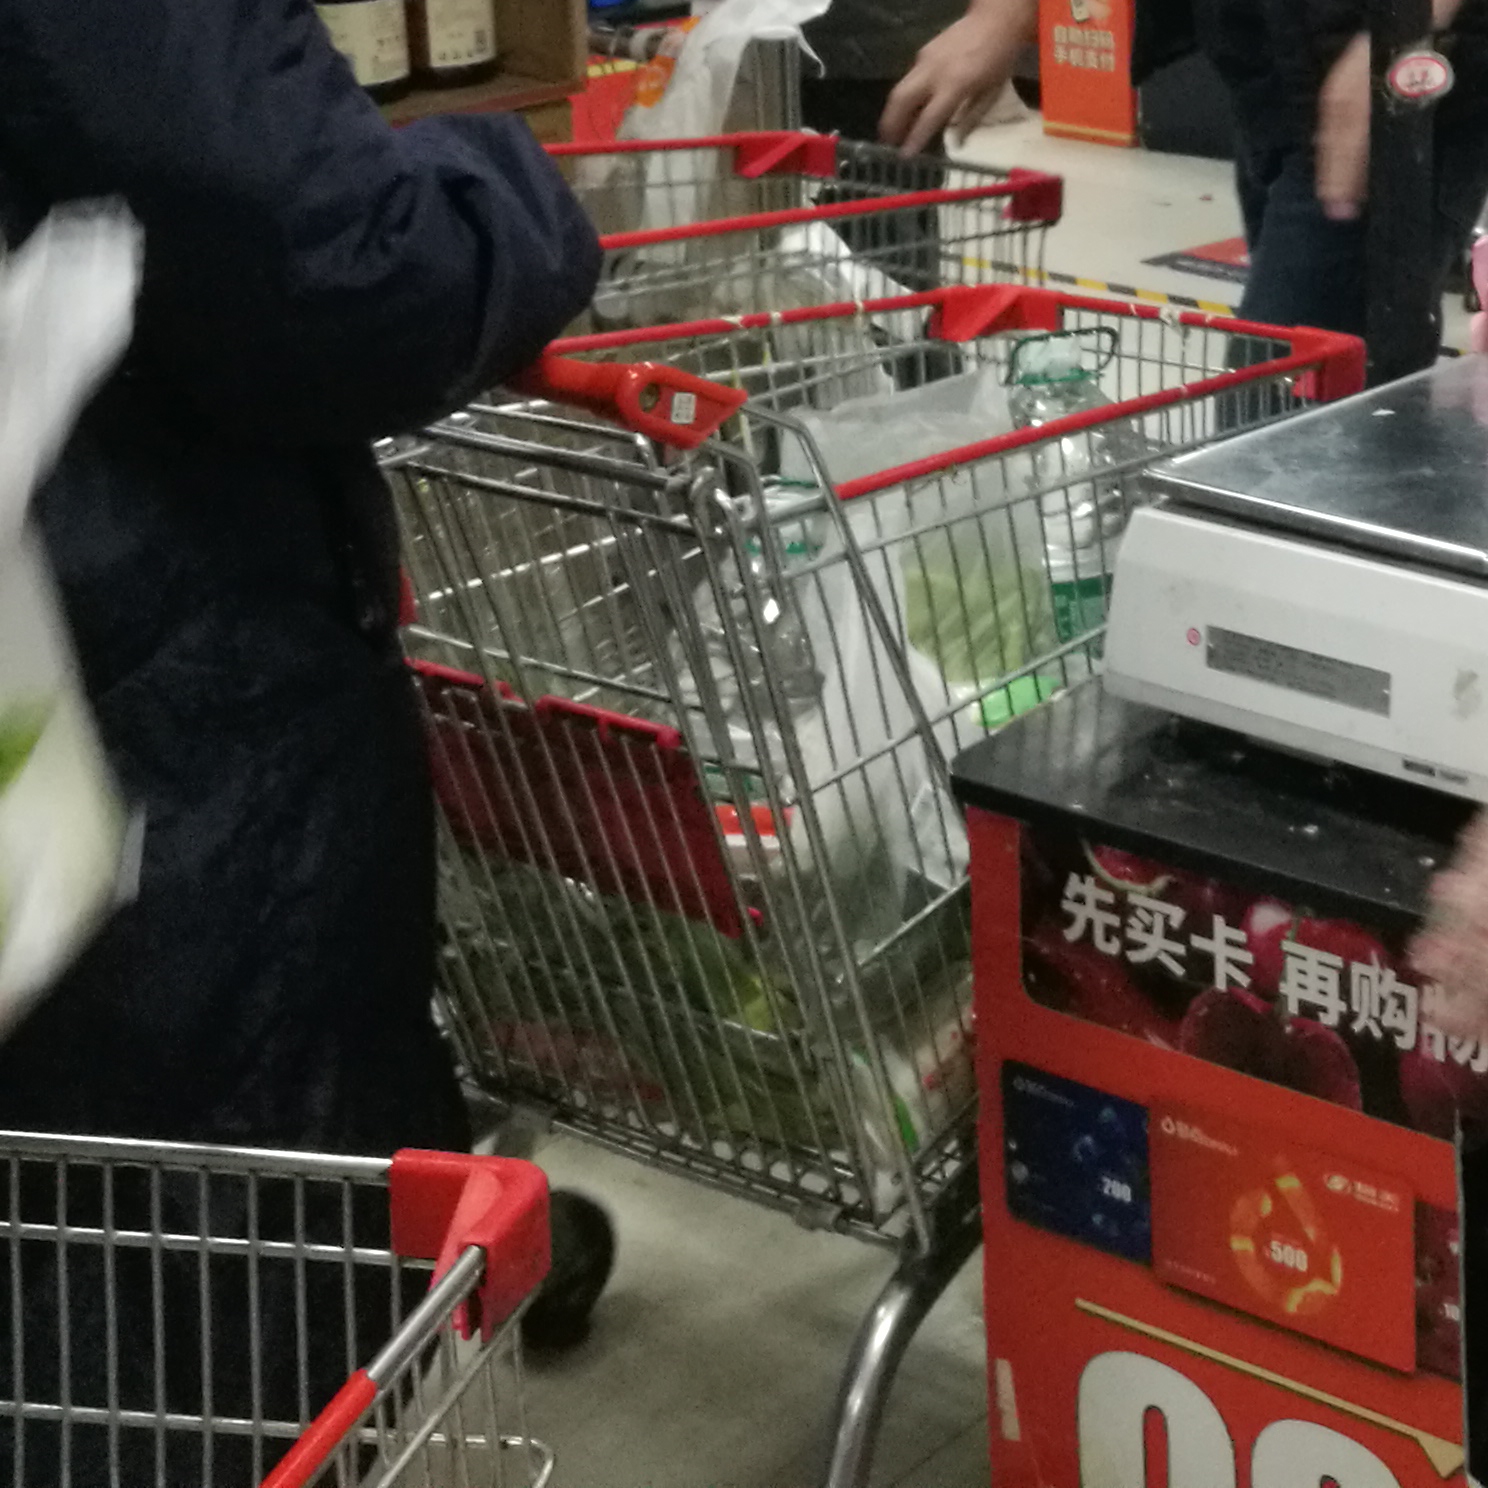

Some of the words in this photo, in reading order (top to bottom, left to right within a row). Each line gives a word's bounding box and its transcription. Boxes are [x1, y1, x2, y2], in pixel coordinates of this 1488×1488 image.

[1060, 871, 1255, 993] 先买卡
[1269, 1239, 1309, 1273] 500
